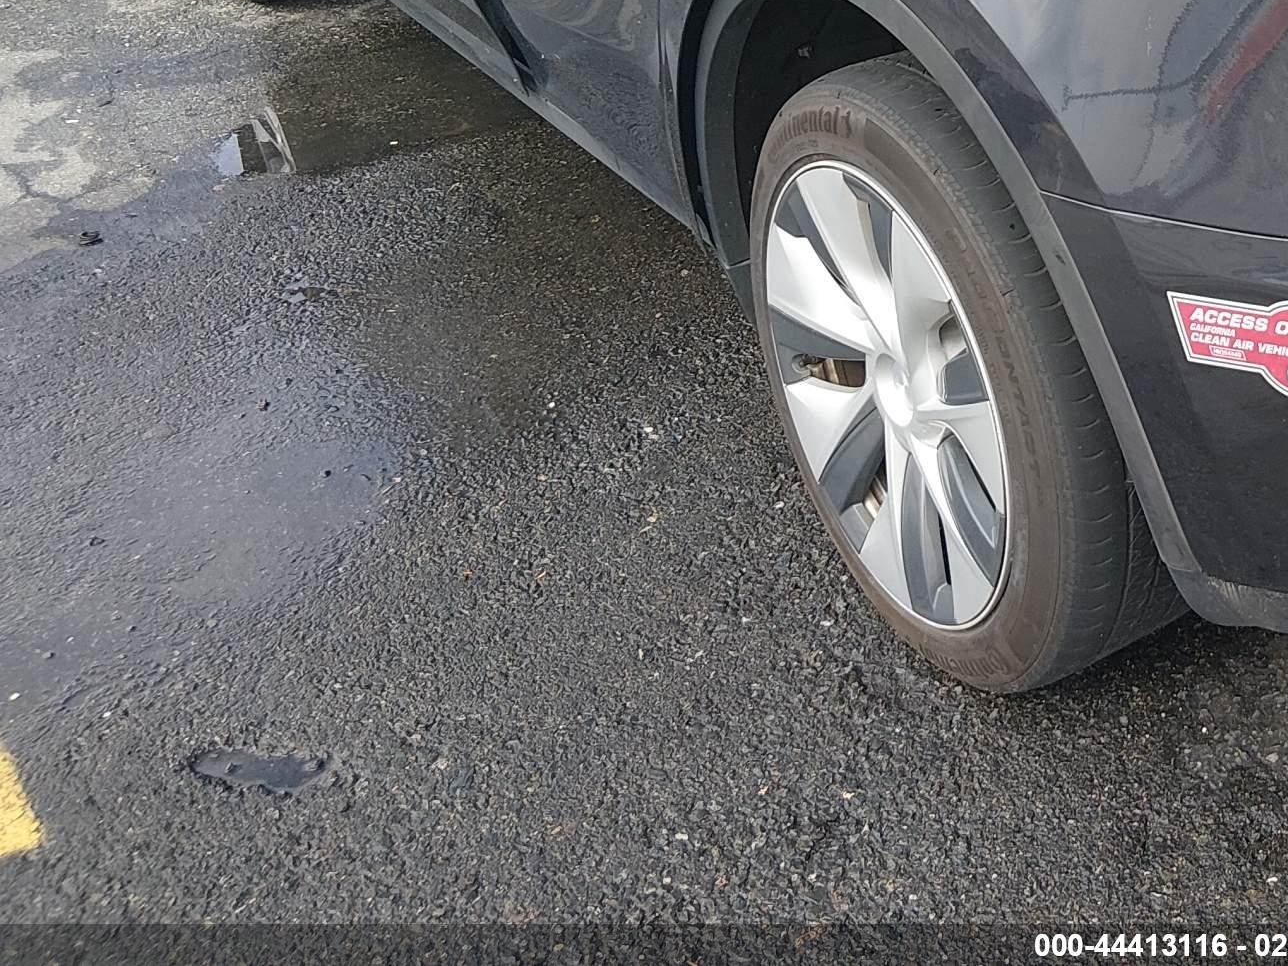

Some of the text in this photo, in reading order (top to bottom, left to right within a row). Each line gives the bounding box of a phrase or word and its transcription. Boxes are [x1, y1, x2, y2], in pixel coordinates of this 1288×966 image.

[1190, 307, 1269, 332] ACCESS
[1190, 323, 1236, 337] CALIFORNIA
[1191, 332, 1229, 347] CLEAN
[1233, 339, 1254, 351] AIR
